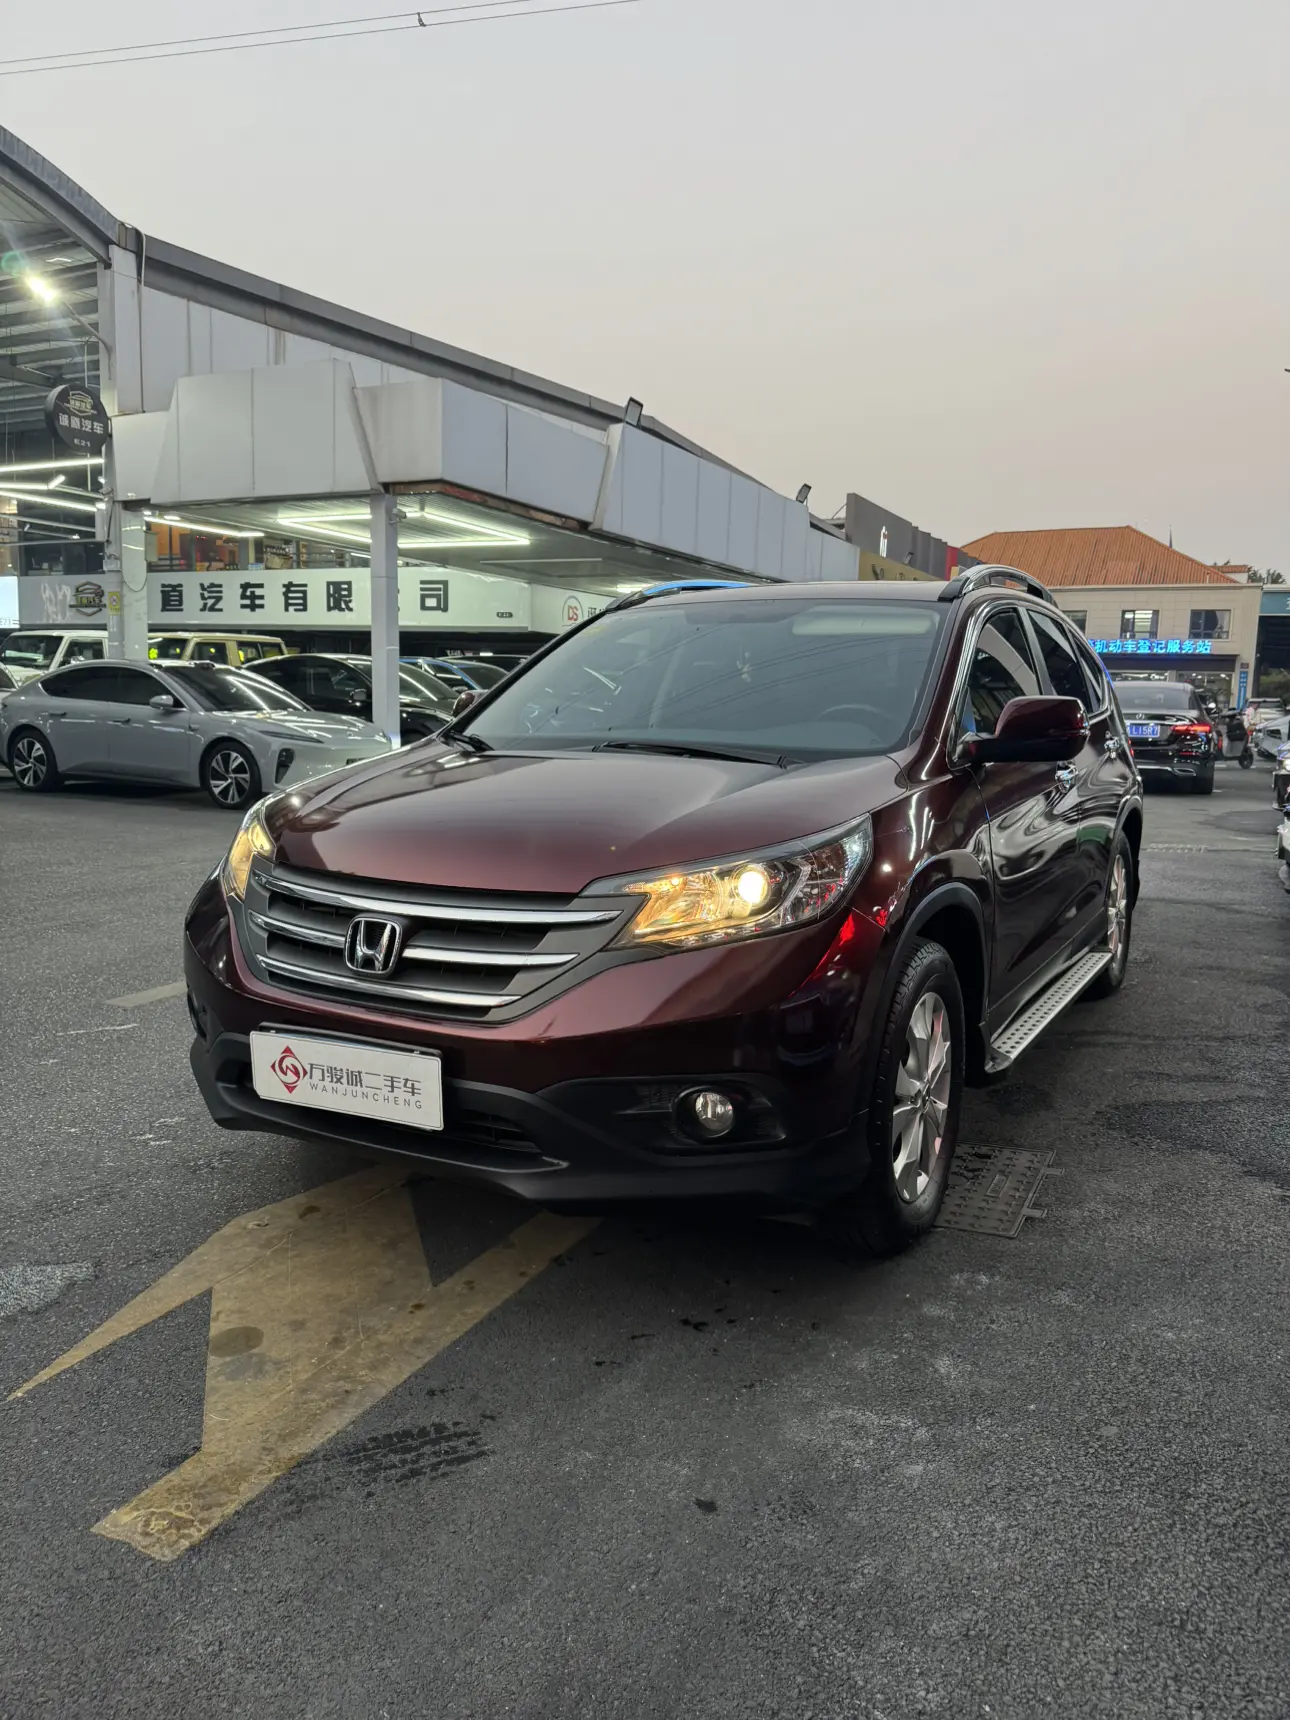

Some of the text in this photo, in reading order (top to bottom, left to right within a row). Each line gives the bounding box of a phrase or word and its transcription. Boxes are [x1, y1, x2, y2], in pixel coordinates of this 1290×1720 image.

[160, 580, 448, 612] 道汽车有限司
[308, 1063, 421, 1096] 万骏诚二手车
[310, 1083, 422, 1109] WANJUNCHENG
